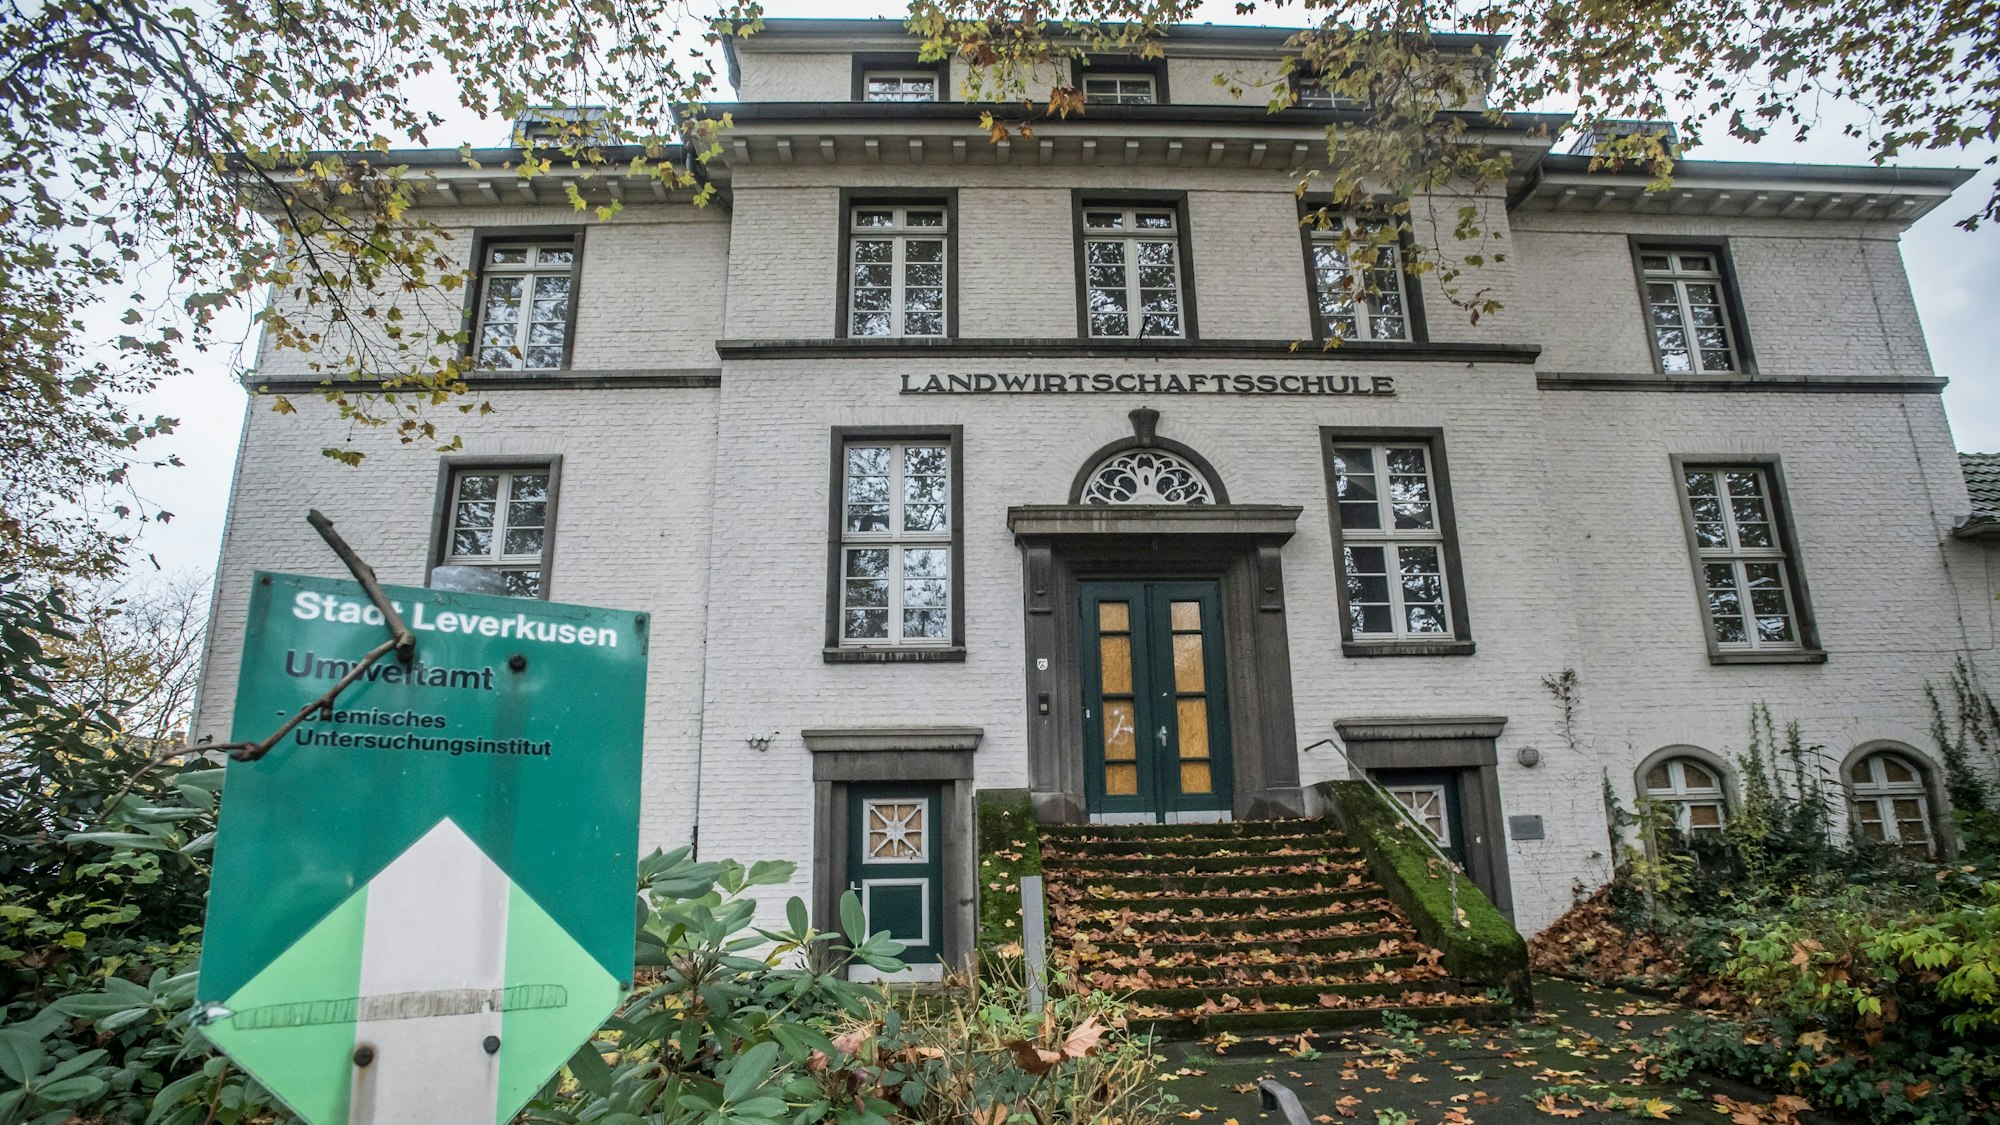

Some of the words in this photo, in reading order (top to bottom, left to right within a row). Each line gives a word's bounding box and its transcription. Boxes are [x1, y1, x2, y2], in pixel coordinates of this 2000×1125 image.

[901, 373, 1395, 393] LANDWIRTSCHAFTSSCHULE
[412, 602, 618, 647] Leverkusen
[295, 728, 552, 757] Untersuchungsinstitut
